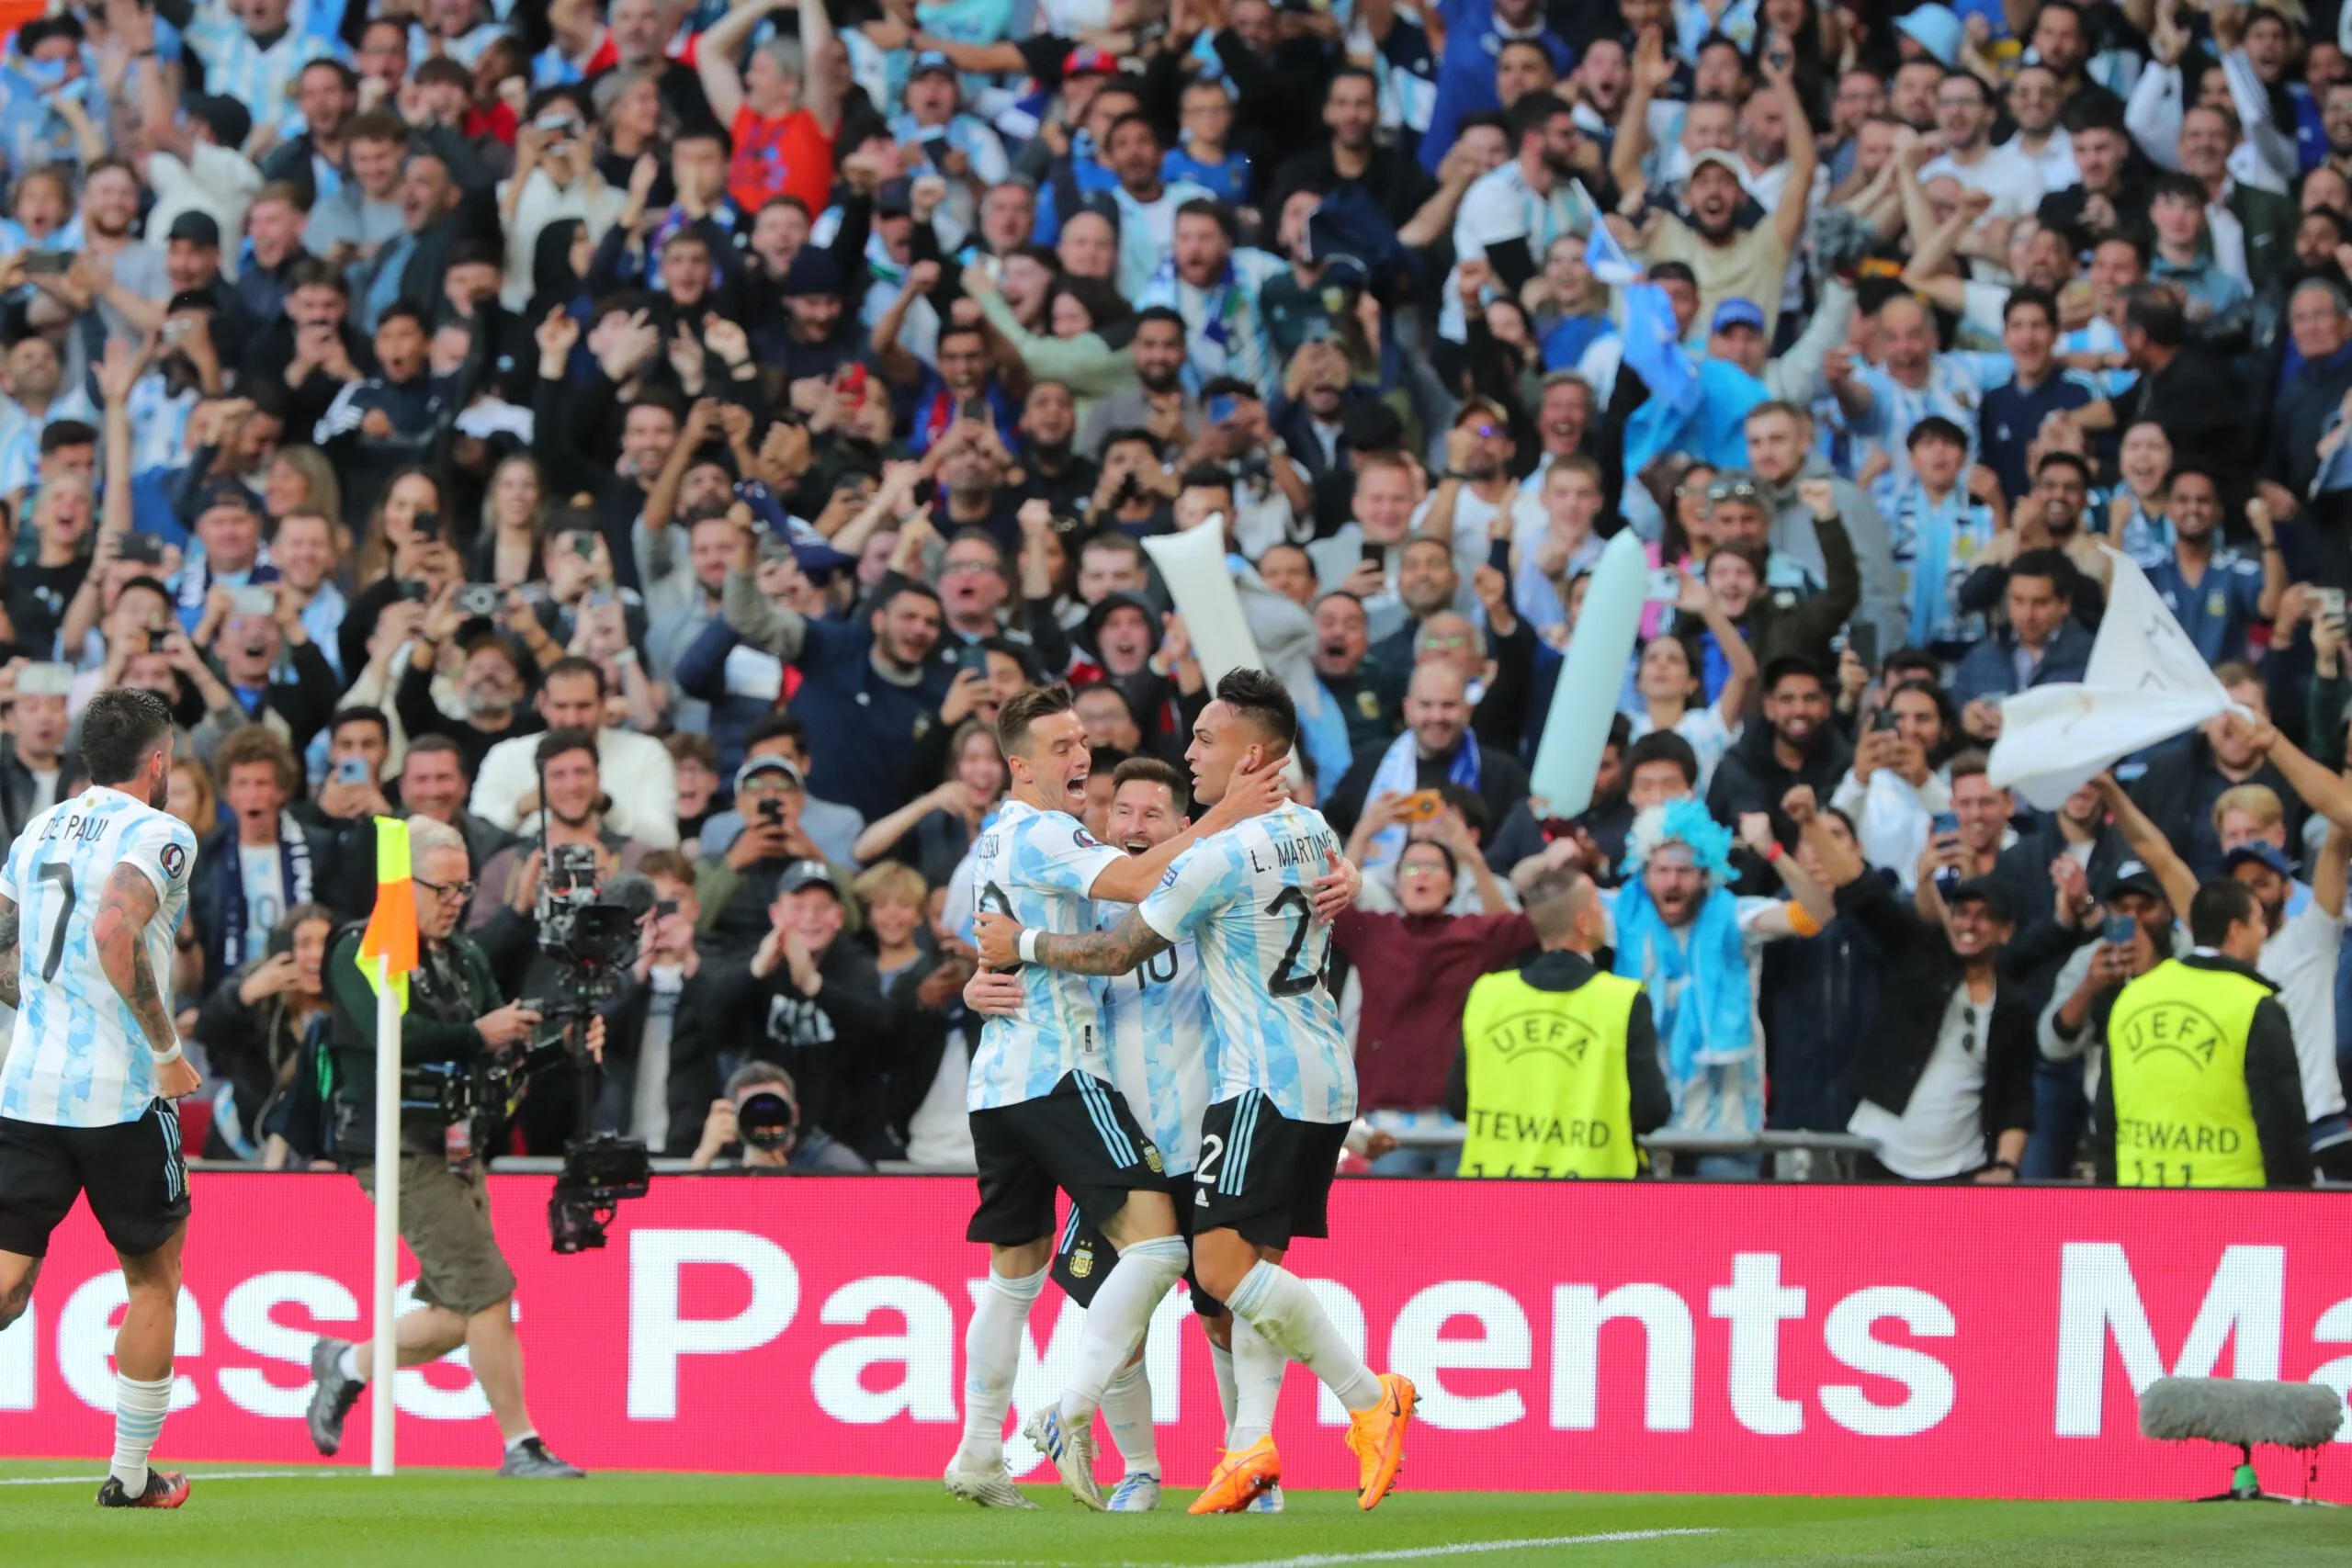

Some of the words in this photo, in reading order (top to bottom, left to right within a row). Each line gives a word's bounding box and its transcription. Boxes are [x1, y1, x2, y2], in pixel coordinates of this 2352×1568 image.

[39, 817, 65, 841] DE
[63, 815, 109, 841] PAUL
[1250, 849, 1272, 874] L.
[38, 862, 76, 984] 7
[1492, 1018, 1589, 1061] UEFA
[2127, 1011, 2218, 1064] UEFA
[1193, 1134, 1224, 1184] 2
